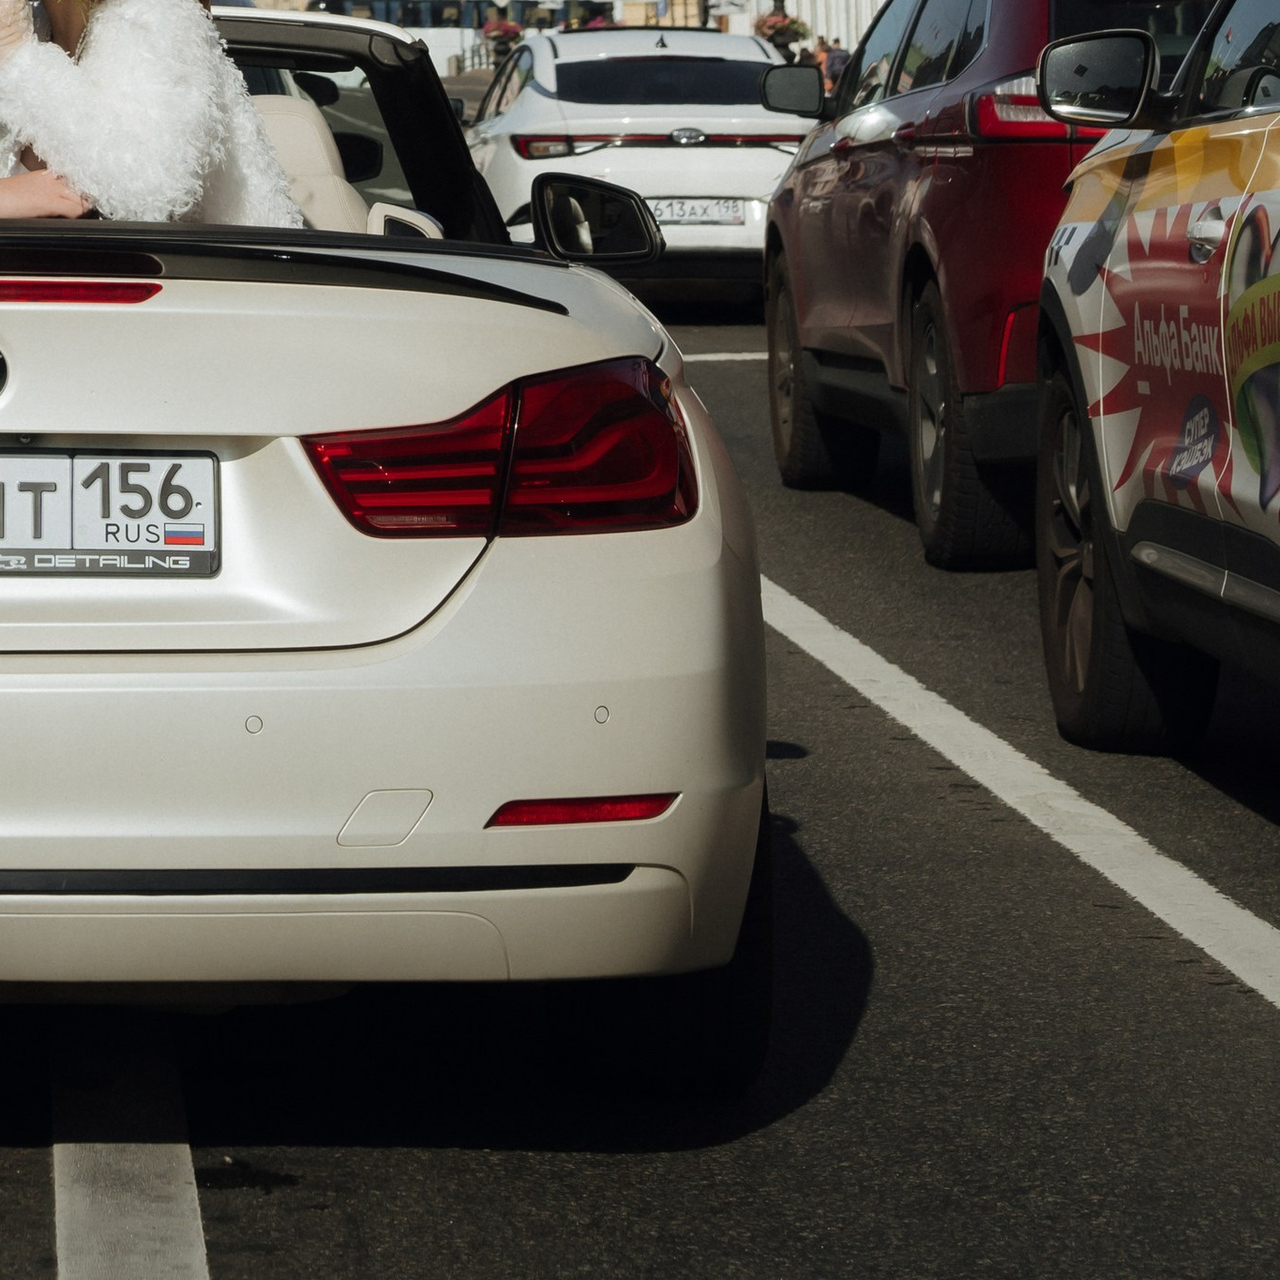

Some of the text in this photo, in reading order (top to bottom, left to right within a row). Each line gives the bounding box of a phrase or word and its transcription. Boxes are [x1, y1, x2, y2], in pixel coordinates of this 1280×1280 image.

[653, 200, 711, 219] 613АХ
[1133, 300, 1223, 386] Альфа Банк
[1184, 406, 1210, 446] СУПЕР
[1169, 433, 1215, 476] КЭШБЭК
[80, 461, 194, 520] 156
[104, 523, 161, 543] RUS
[34, 554, 191, 569] DETAILING
